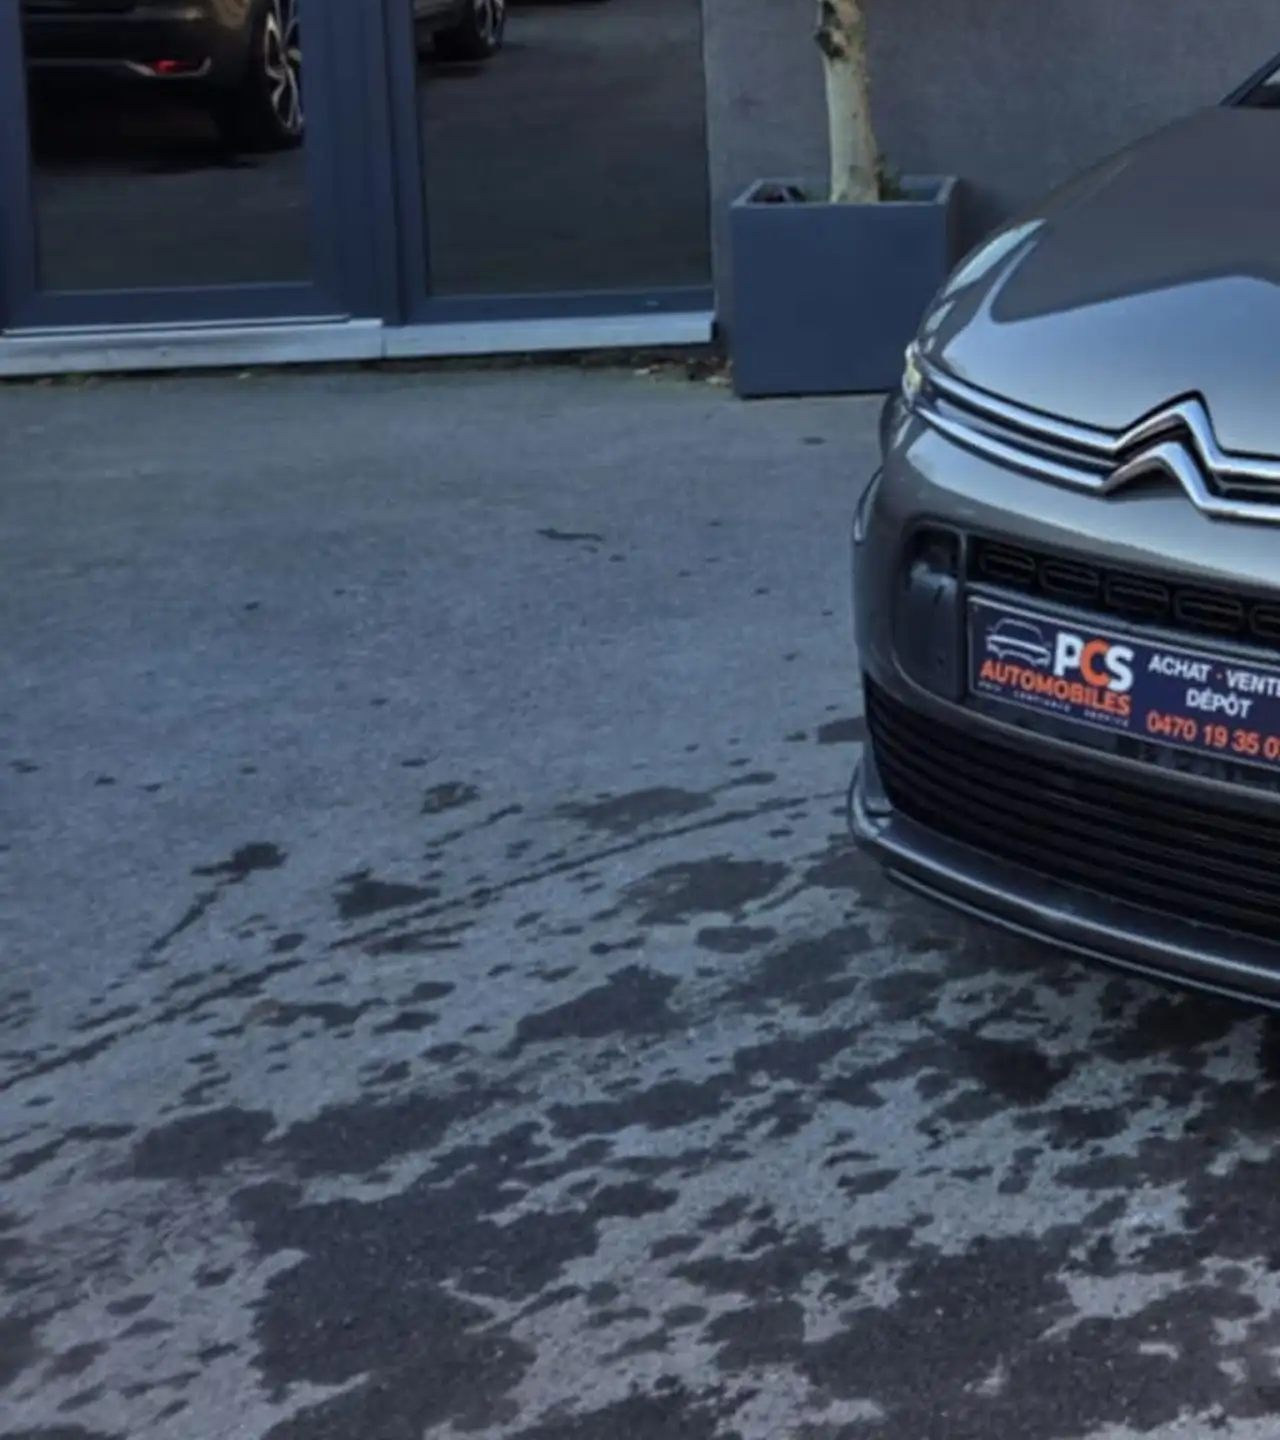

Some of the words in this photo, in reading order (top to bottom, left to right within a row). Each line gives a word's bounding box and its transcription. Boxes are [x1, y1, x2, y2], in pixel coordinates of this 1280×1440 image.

[1053, 631, 1135, 692] PCS
[1148, 654, 1212, 684] ACHAT
[979, 660, 1132, 716] AUTOMOBILES
[1185, 688, 1253, 719] DÉPÔT
[1146, 710, 1198, 741] 0470
[1202, 724, 1228, 748] 19
[1231, 731, 1261, 756] 35
